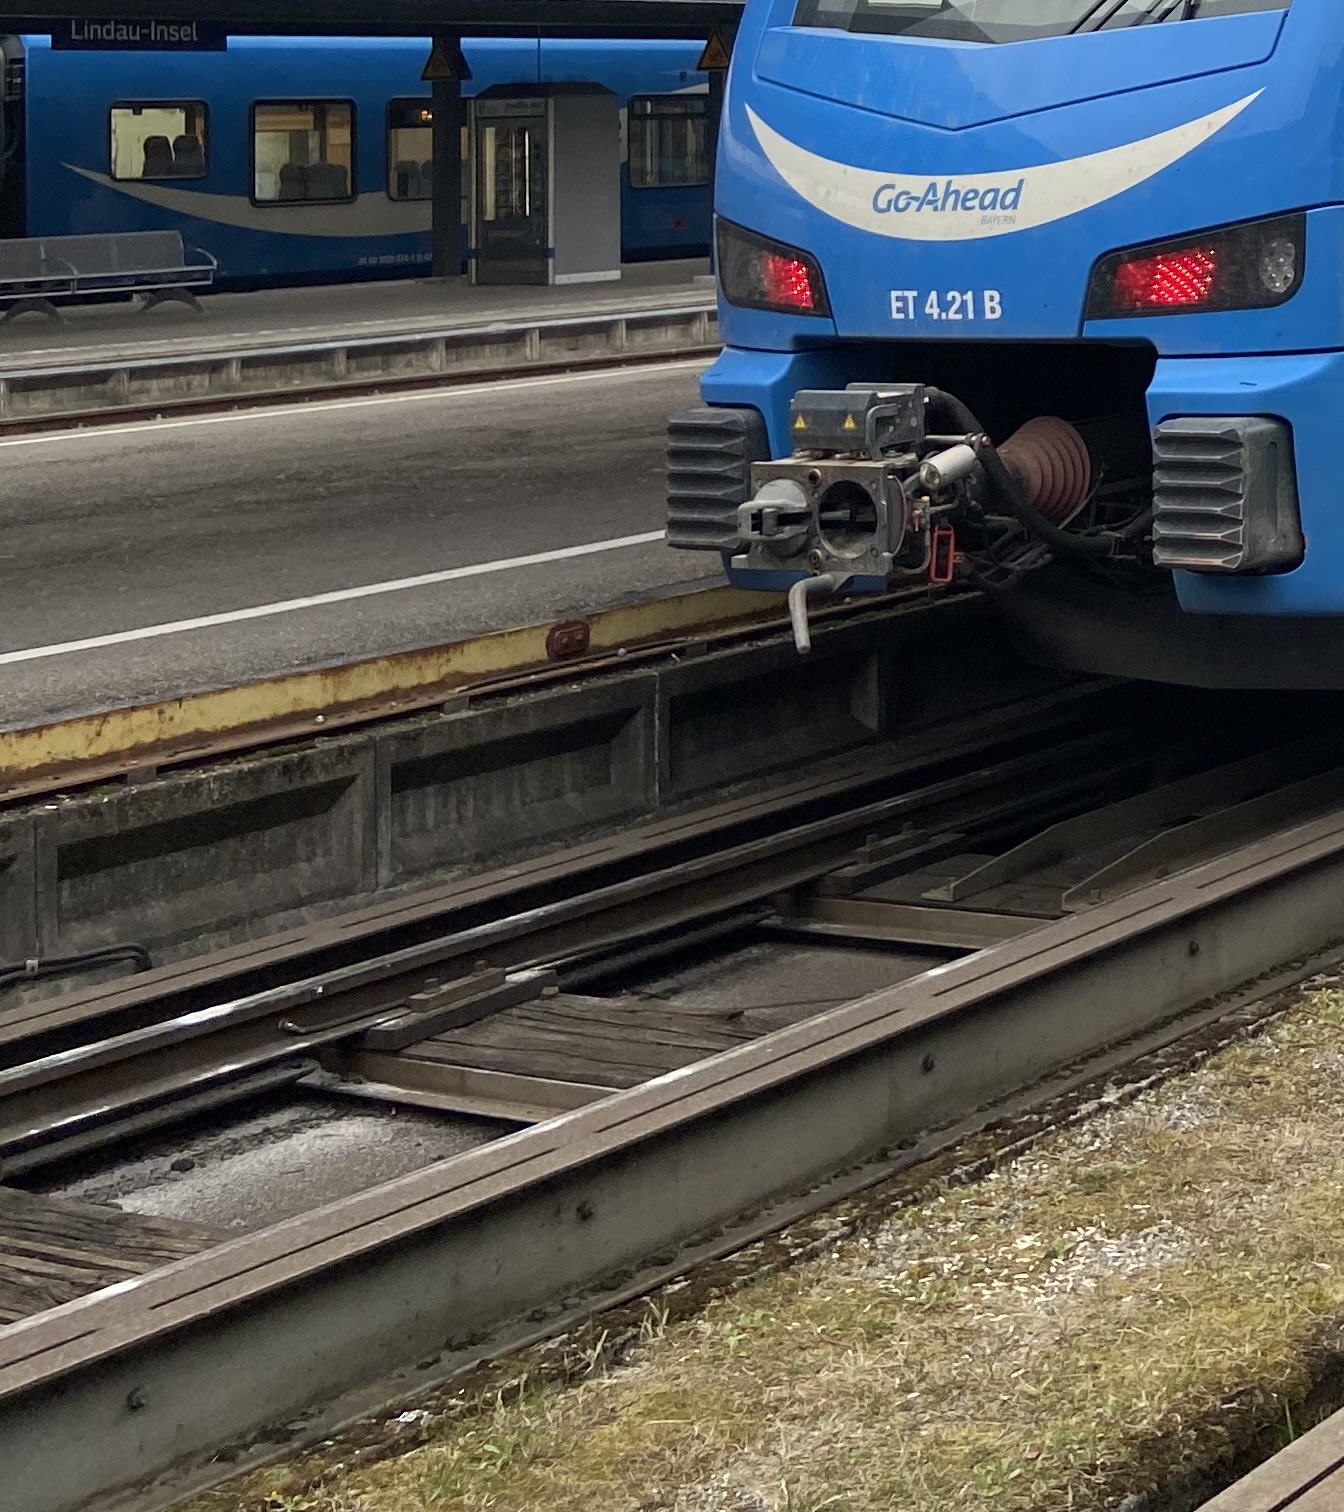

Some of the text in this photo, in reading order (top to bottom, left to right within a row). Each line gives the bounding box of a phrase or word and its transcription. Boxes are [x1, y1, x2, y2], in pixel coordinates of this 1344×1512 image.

[70, 19, 198, 42] Lindau-Insel
[980, 214, 1016, 226] BAYERN
[890, 289, 1003, 320] ET 4.21 B
